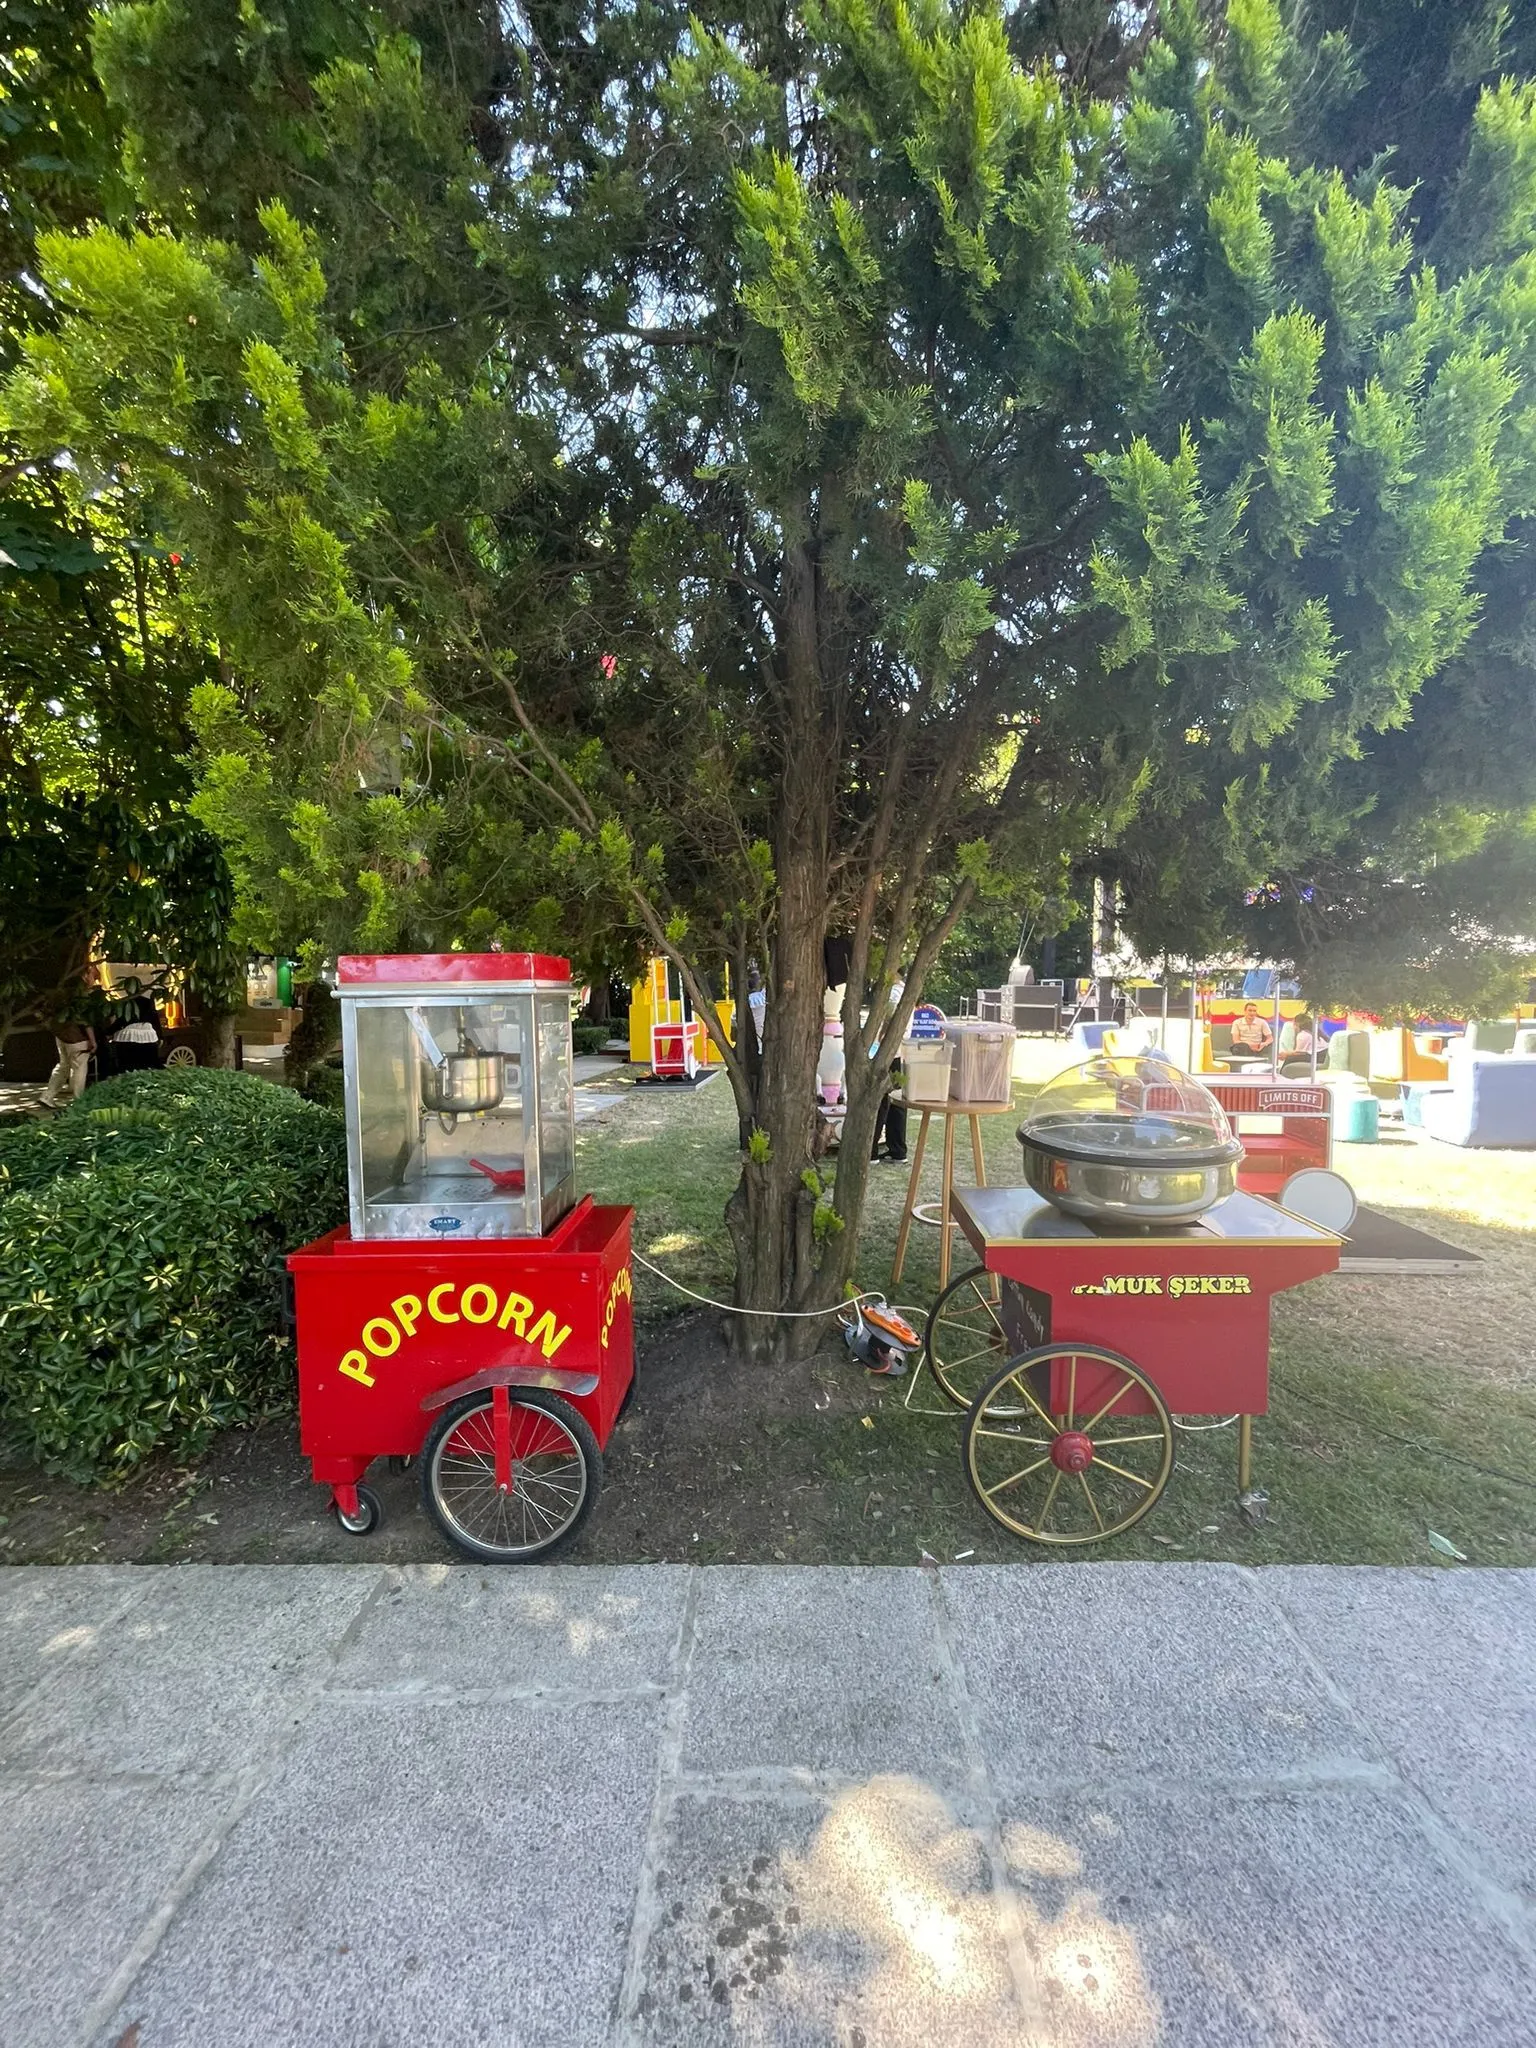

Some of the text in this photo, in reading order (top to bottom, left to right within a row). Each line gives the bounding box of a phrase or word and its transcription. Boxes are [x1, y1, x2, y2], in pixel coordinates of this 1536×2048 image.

[1264, 1092, 1318, 1104] LIMITS OFF
[1072, 1275, 1252, 1299] MUK ŞEKER
[338, 1282, 573, 1388] POPCORN
